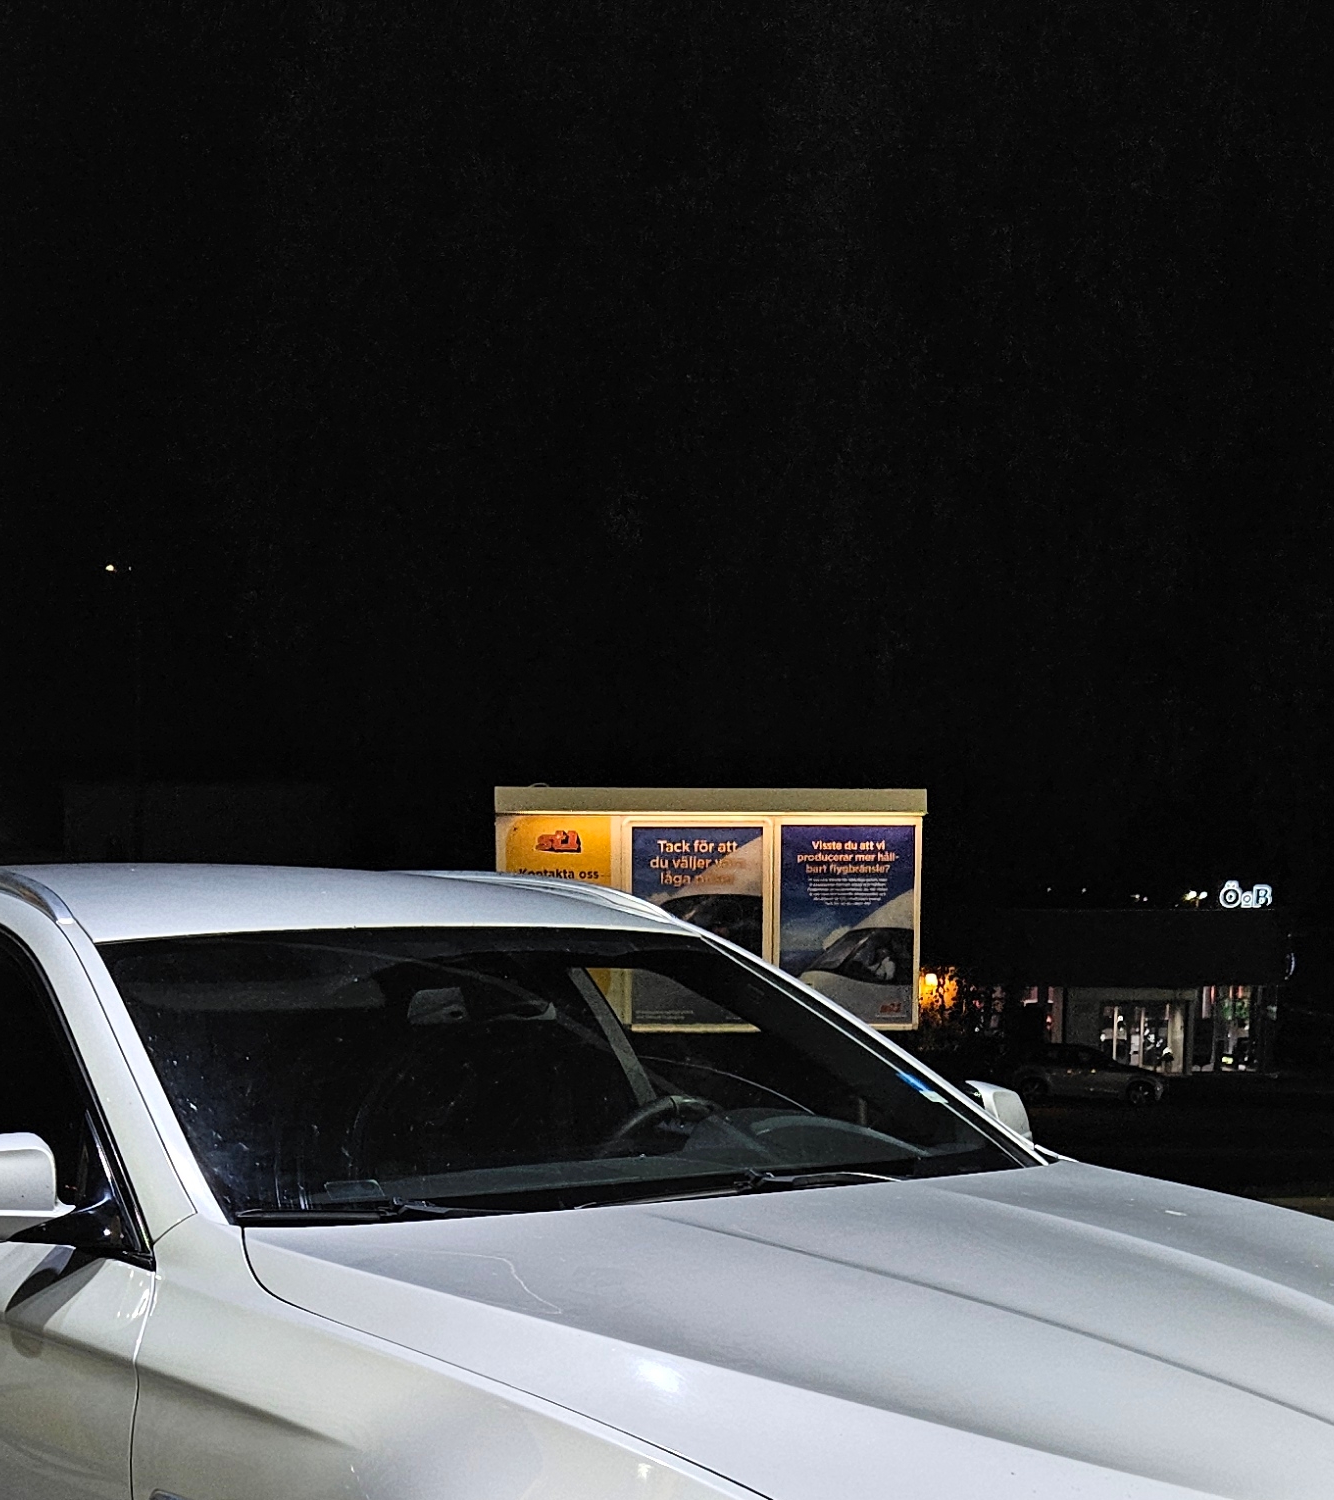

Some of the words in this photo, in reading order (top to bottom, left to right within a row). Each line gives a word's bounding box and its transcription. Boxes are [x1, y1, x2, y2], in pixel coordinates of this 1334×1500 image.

[657, 839, 691, 854] Tack
[693, 839, 715, 853] för
[717, 840, 738, 853] att
[812, 840, 843, 850] Visste
[844, 840, 858, 850] du
[860, 840, 874, 850] att
[876, 840, 885, 850] vi
[650, 856, 669, 869] du
[672, 855, 712, 871] väljer
[797, 852, 853, 863] producerar
[855, 853, 875, 862] mer
[579, 870, 599, 879] oss
[806, 864, 827, 874] bart
[660, 870, 691, 887] låga
